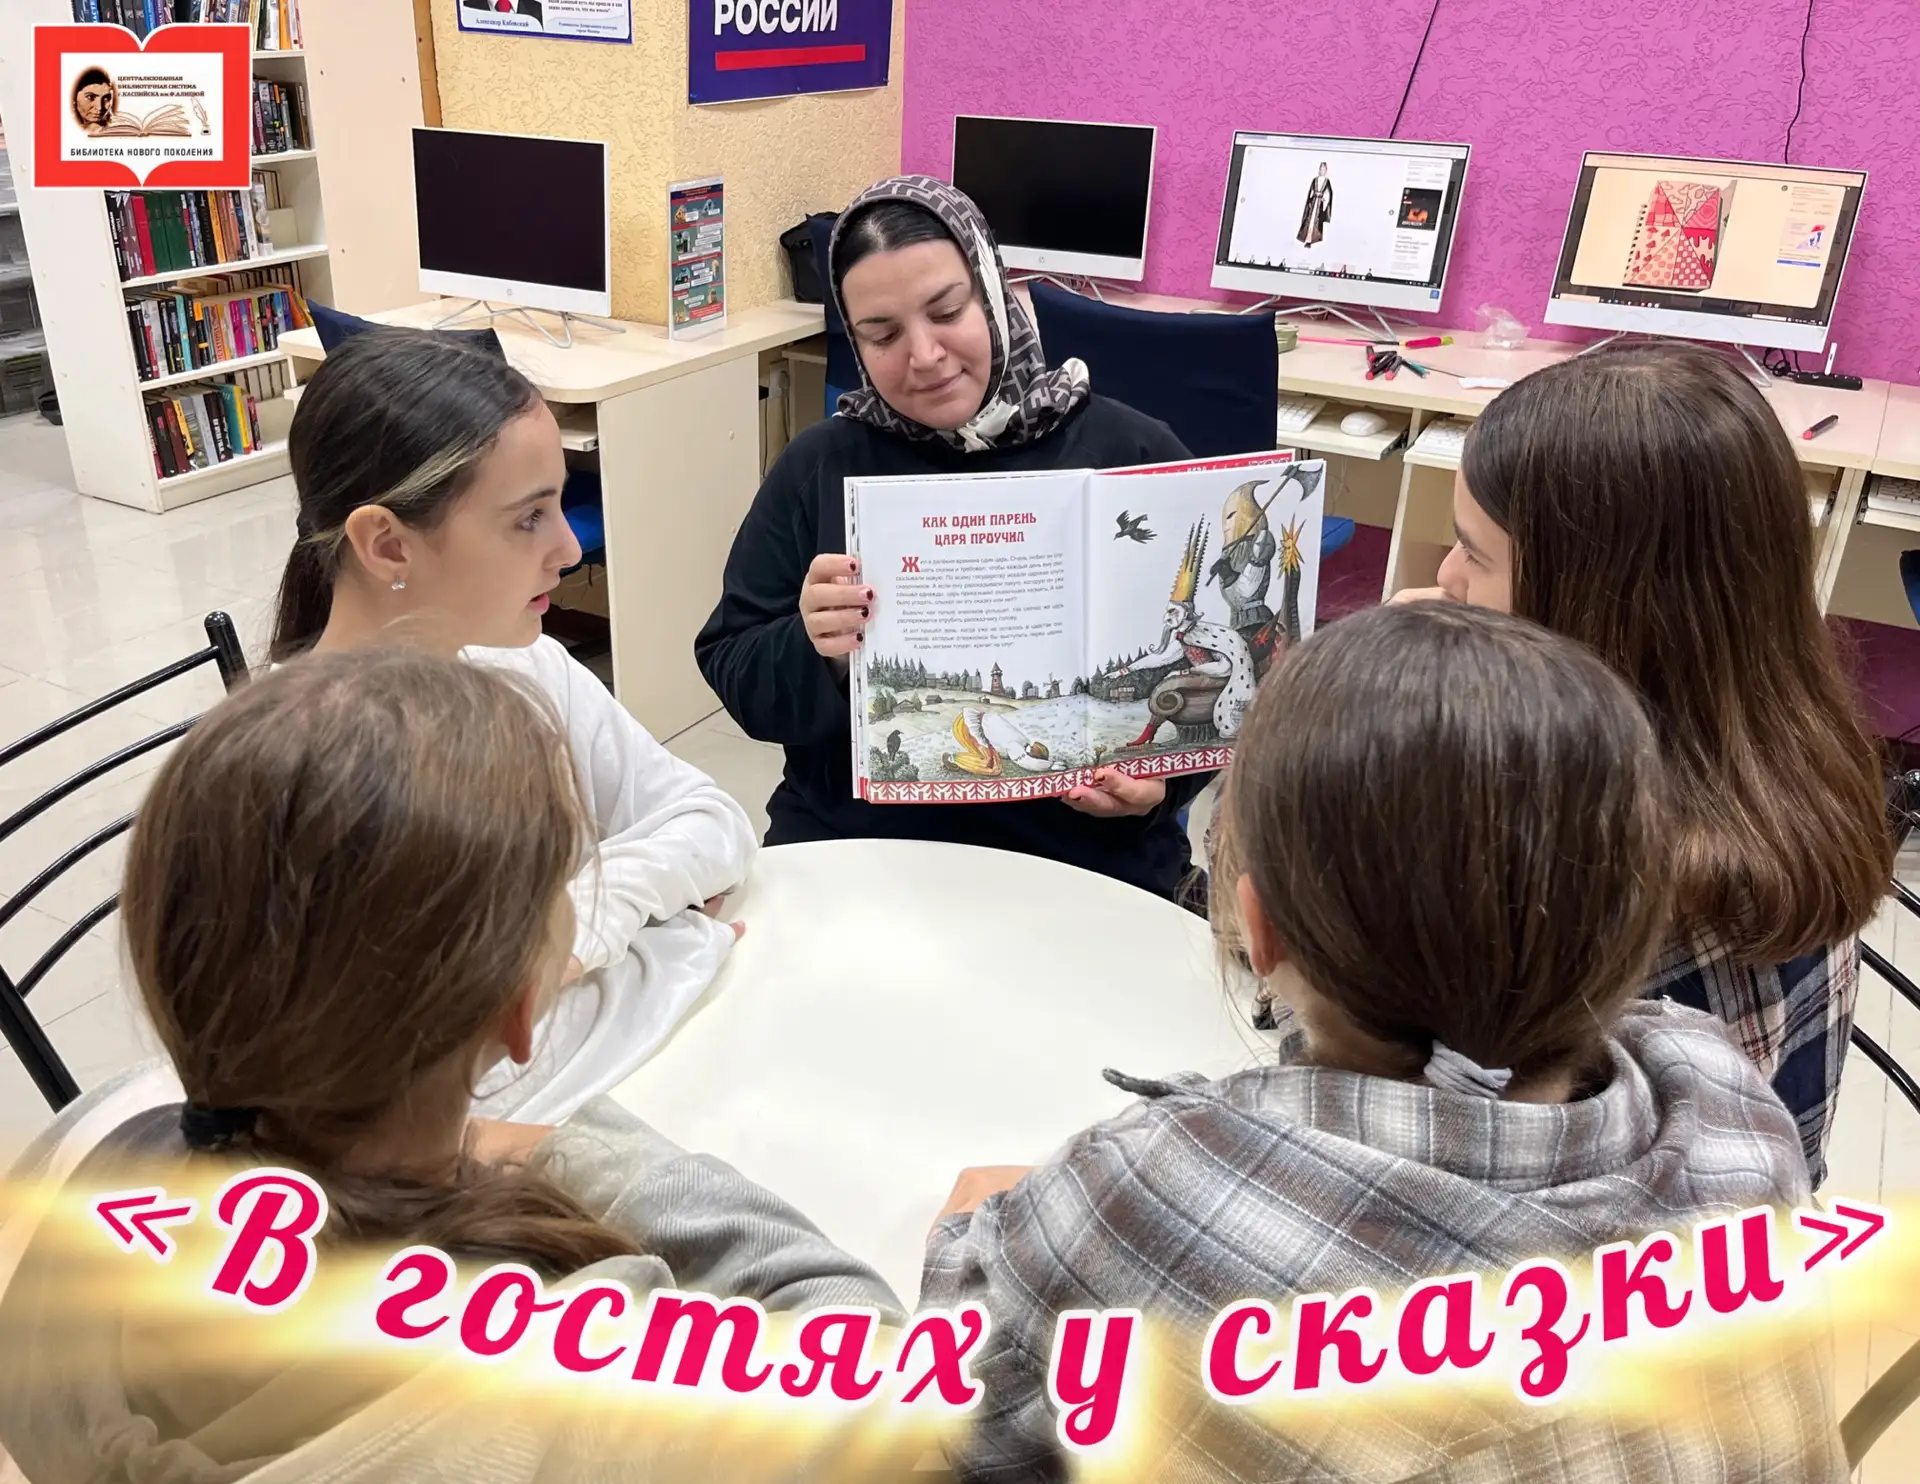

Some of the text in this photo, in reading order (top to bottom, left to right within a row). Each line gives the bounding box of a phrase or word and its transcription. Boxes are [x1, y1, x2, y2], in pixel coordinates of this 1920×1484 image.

[714, 0, 838, 35] РОССИИ
[922, 512, 1037, 528] КАК ОДИН ПАРЕНЬ
[934, 532, 1024, 546] ЦАРЯ ПРОУЧИЛ
